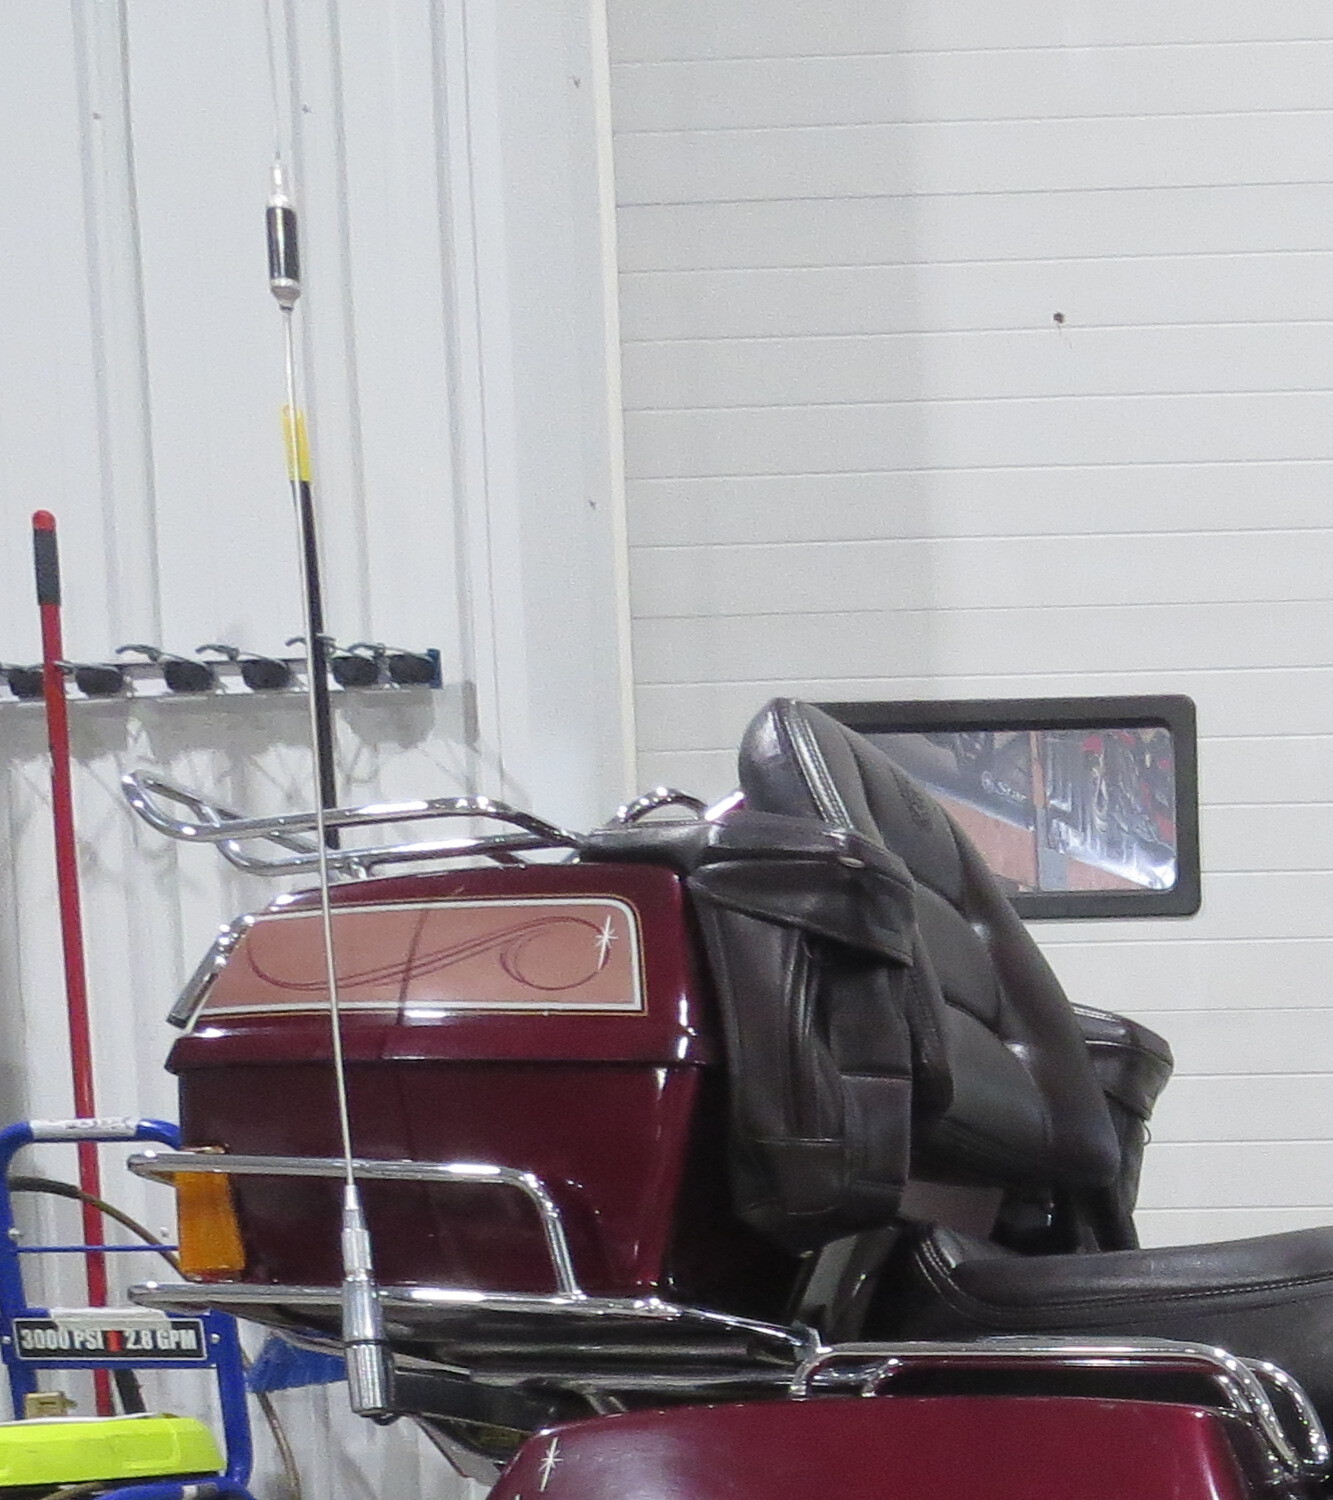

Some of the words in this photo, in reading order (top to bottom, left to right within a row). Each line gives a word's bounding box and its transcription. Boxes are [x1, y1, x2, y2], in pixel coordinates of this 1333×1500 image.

[20, 1328, 70, 1350] 3000
[74, 1328, 105, 1350] PSI
[124, 1328, 153, 1350] 2.8
[157, 1328, 198, 1350] GPM
